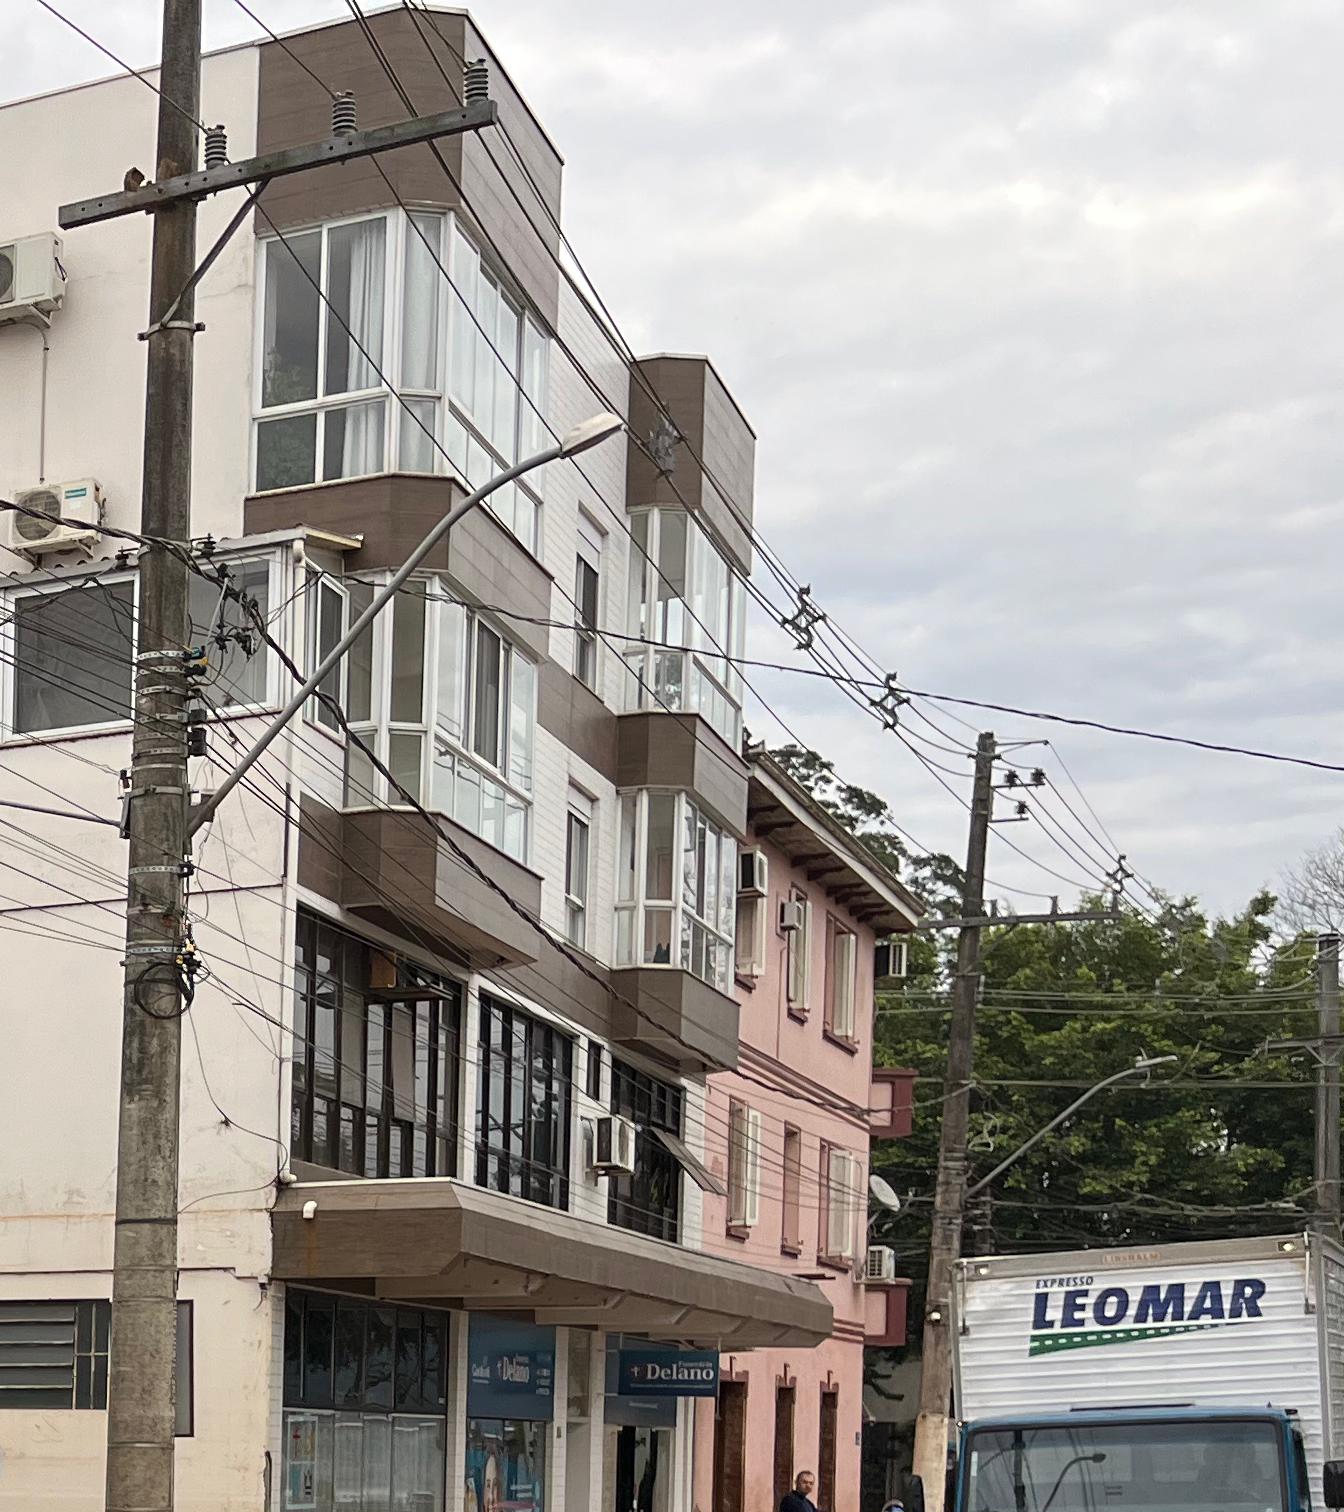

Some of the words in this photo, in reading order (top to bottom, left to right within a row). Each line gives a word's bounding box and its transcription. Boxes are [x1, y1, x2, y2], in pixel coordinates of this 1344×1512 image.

[1035, 1276, 1094, 1289] EXPRESSO
[1032, 1278, 1267, 1330] LEOMAR
[646, 1363, 714, 1380] Delano
